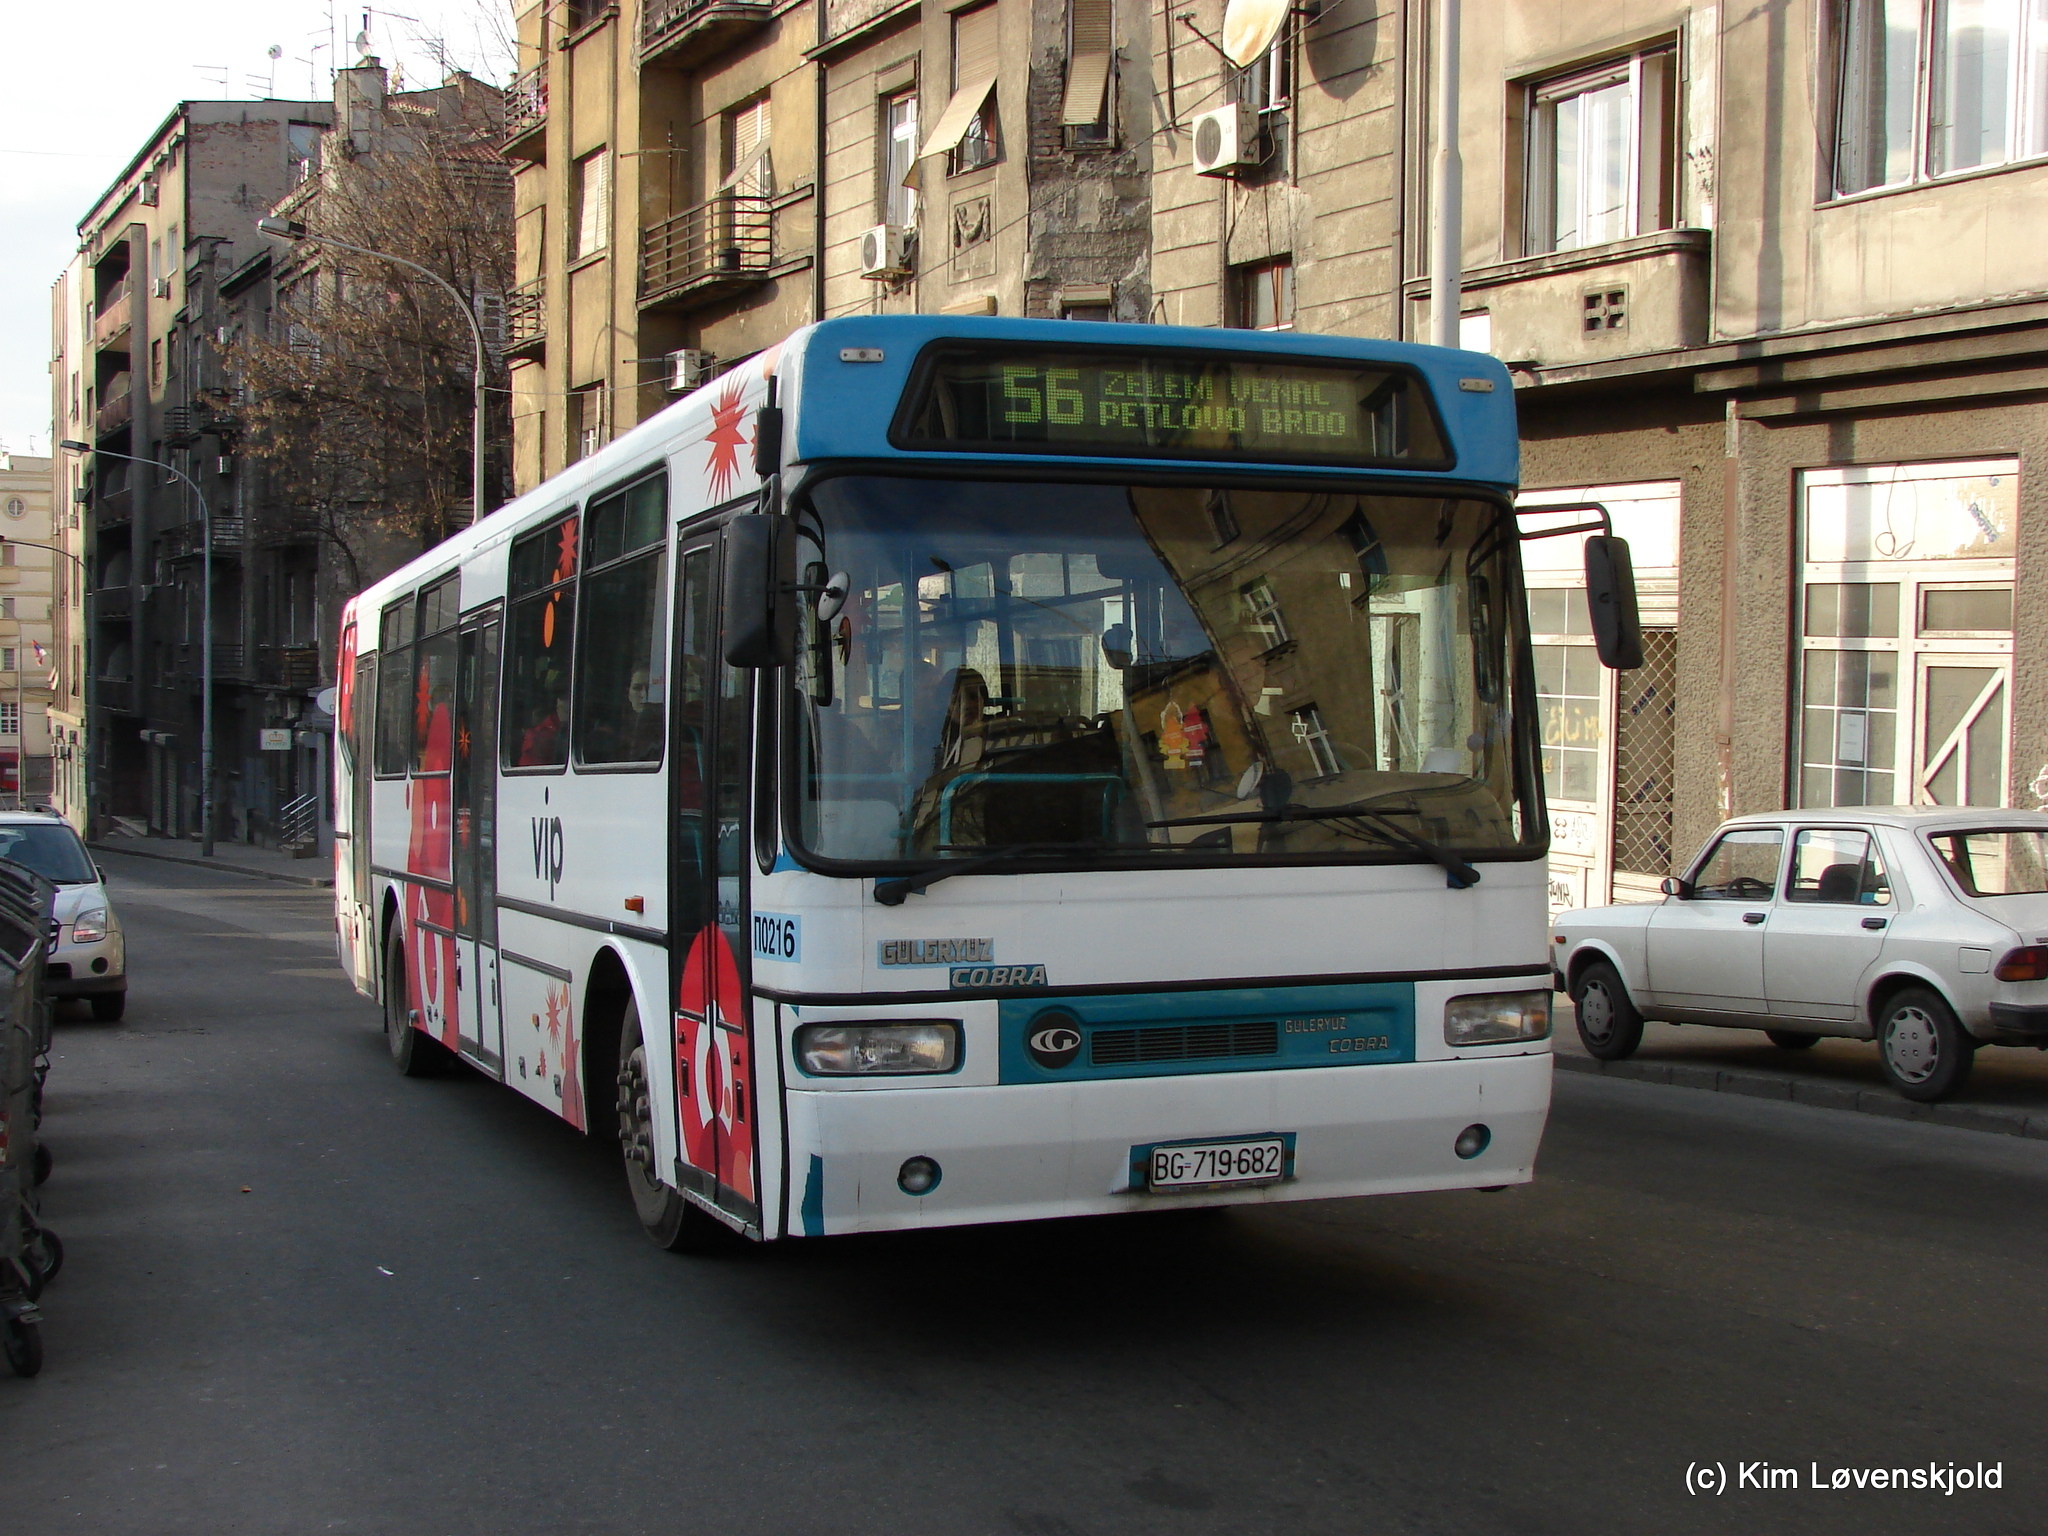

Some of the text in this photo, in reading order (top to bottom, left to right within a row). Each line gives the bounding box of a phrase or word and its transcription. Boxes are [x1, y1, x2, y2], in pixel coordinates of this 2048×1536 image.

[1003, 366, 1084, 424] 56
[1099, 401, 1346, 436] PETLOVO BRDO
[951, 966, 1046, 988] COBRA
[1329, 1036, 1389, 1053] COBRA
